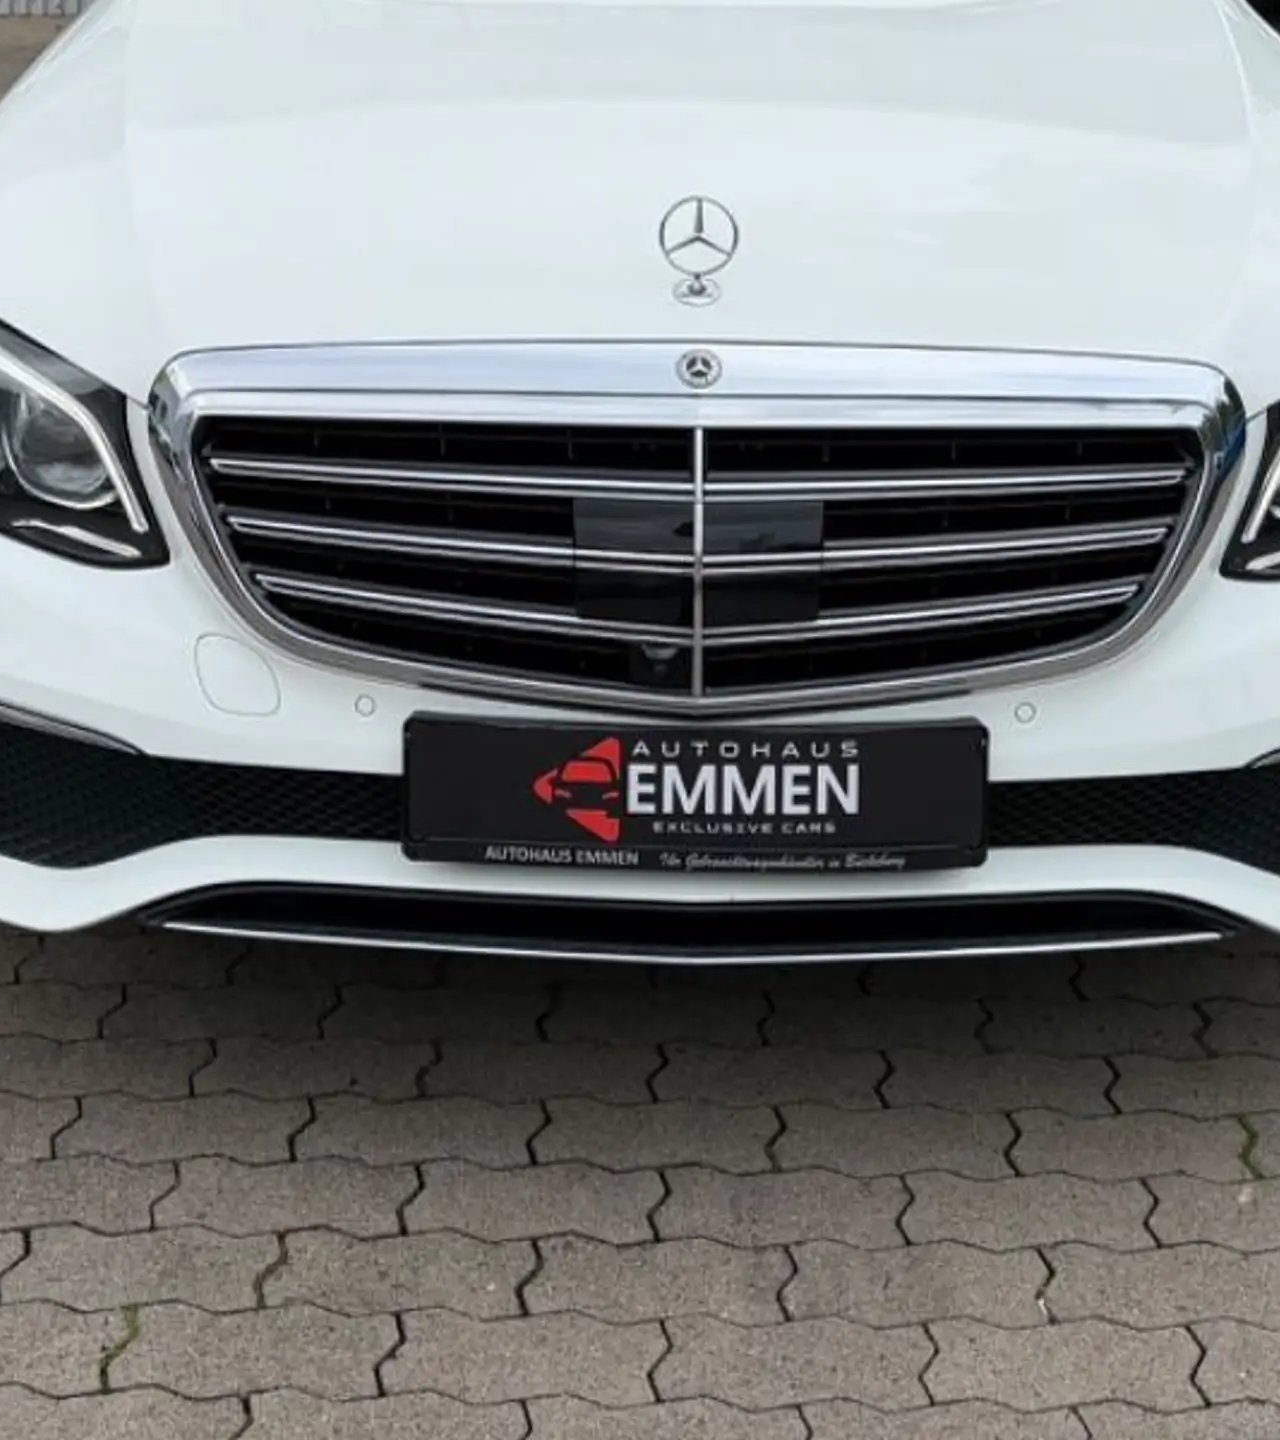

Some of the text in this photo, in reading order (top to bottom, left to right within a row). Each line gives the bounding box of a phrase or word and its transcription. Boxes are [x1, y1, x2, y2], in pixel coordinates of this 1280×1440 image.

[631, 739, 860, 759] AUTOHAUS
[626, 763, 861, 816] EMMEN
[652, 821, 837, 835] EXCLUSIVE CARS
[484, 845, 573, 864] AUTOHAUS
[575, 848, 640, 866] EMMEN
